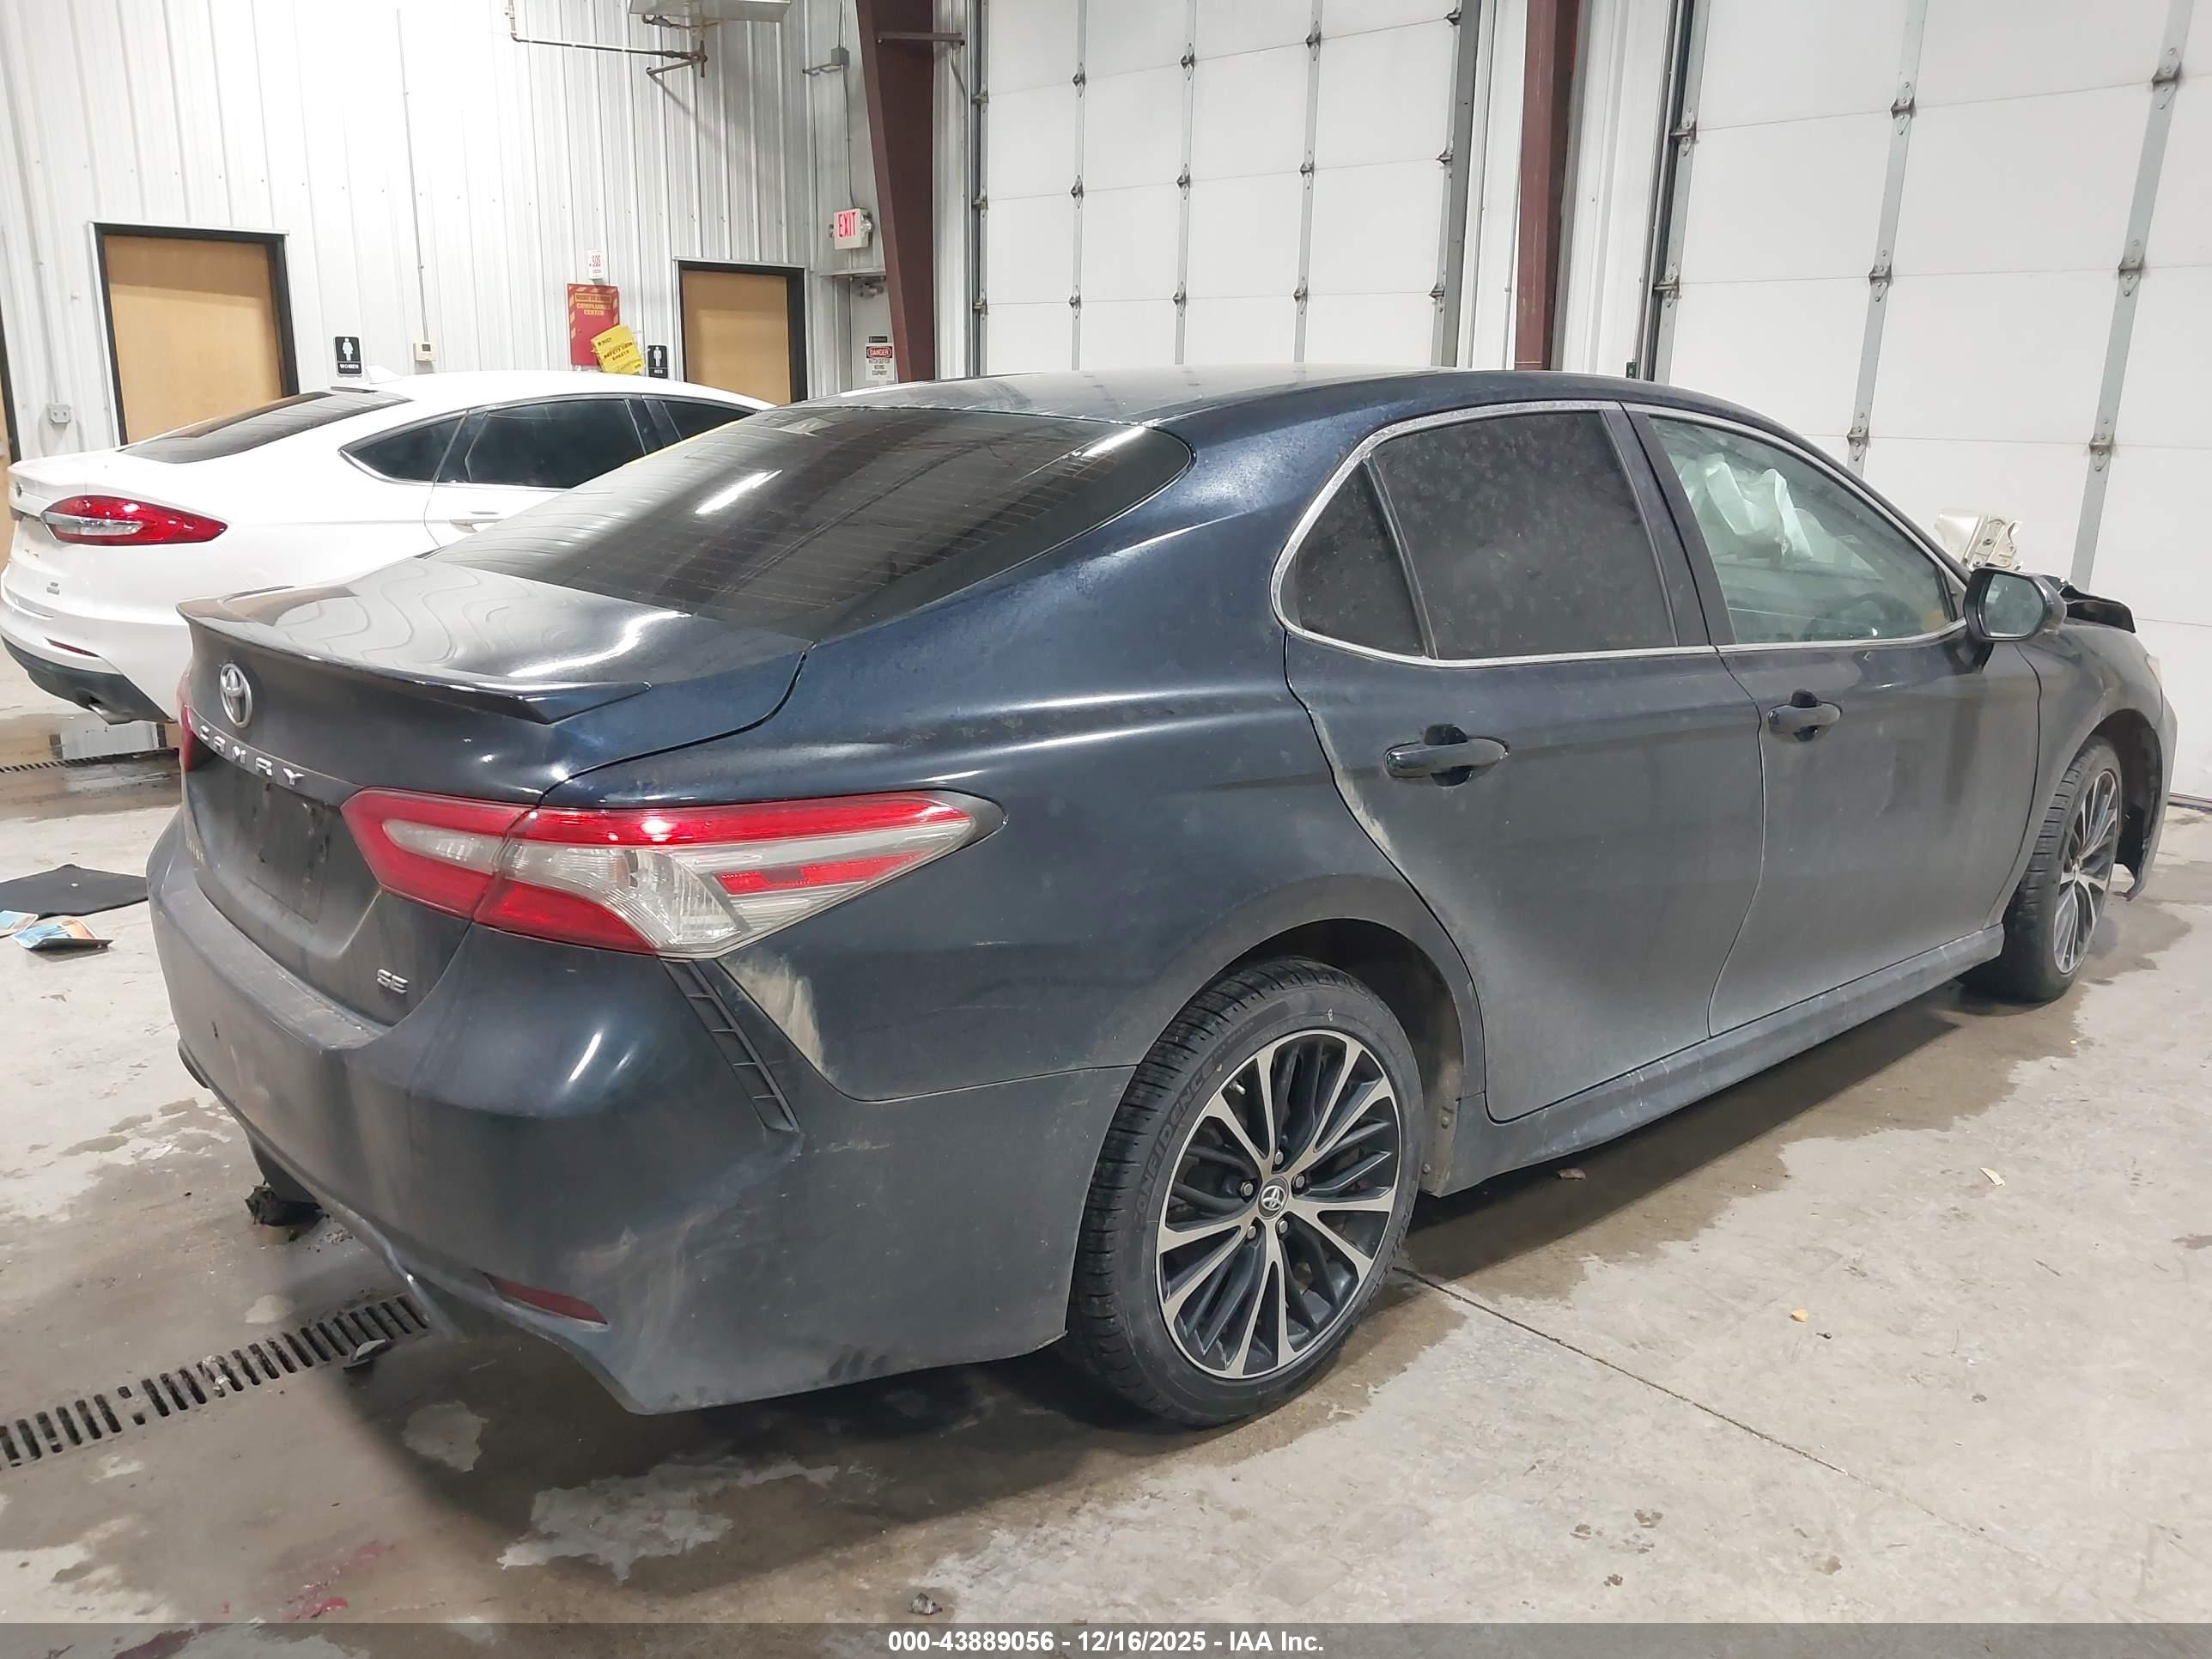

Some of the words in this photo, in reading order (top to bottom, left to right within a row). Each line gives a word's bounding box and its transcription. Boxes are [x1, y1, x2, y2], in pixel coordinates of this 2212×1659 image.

[838, 212, 856, 237] EXIT
[200, 725, 305, 786] CAMRY
[377, 969, 409, 994] SE
